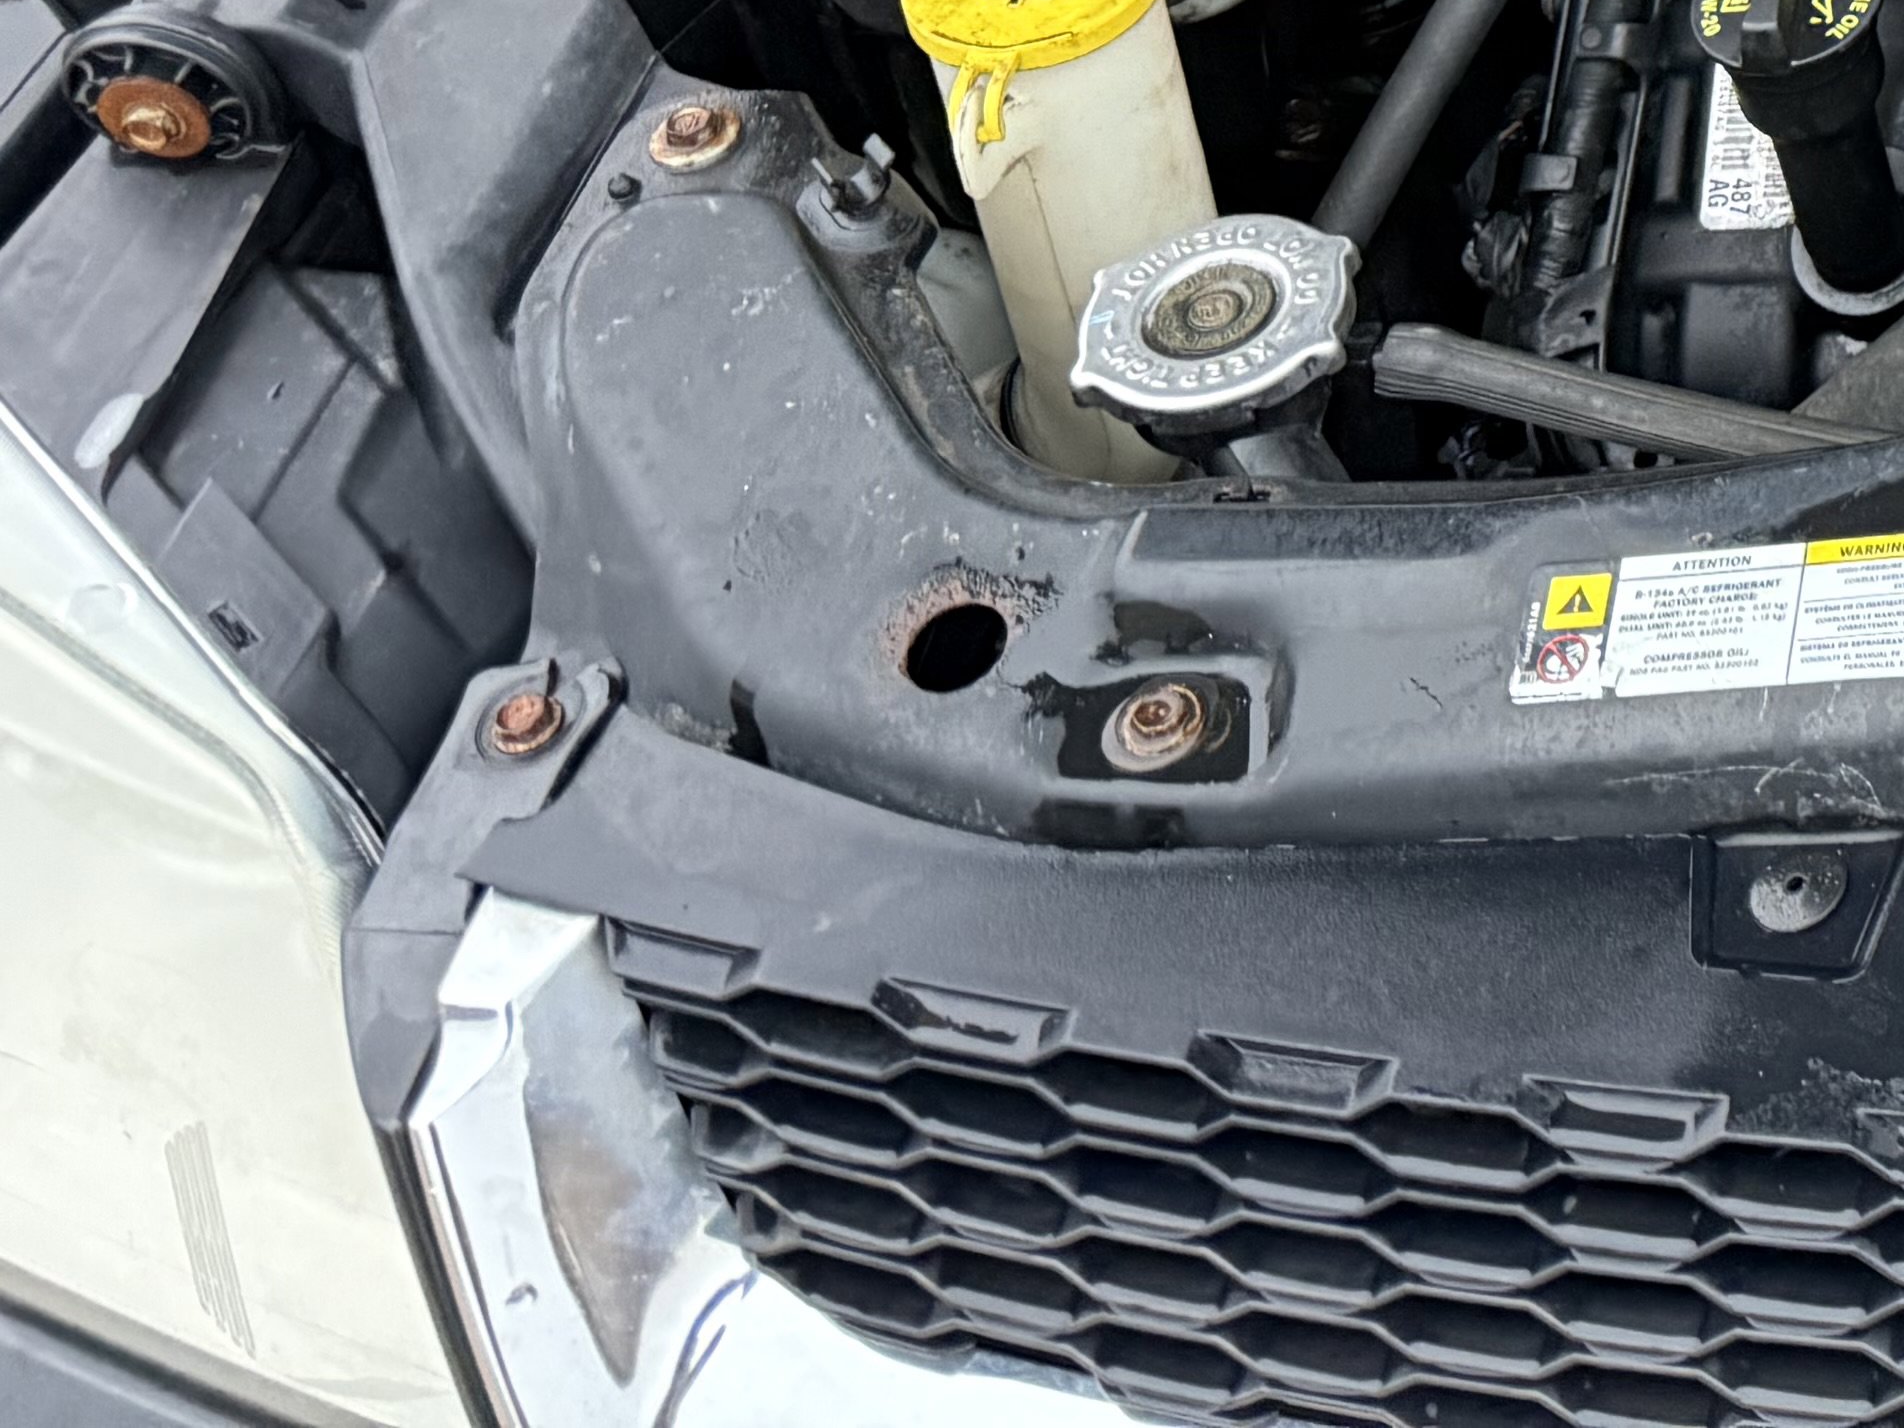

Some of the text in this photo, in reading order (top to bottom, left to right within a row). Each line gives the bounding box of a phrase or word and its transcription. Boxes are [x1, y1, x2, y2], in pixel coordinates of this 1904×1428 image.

[1825, 14, 1859, 40] OIL
[1708, 179, 1730, 208] AG
[1730, 178, 1752, 217] 487
[1179, 339, 1274, 388] KEEP
[1672, 555, 1752, 572] ATTENTION
[1653, 596, 1704, 609] FACTORY
[1643, 648, 1724, 665] COMPRESSOR
